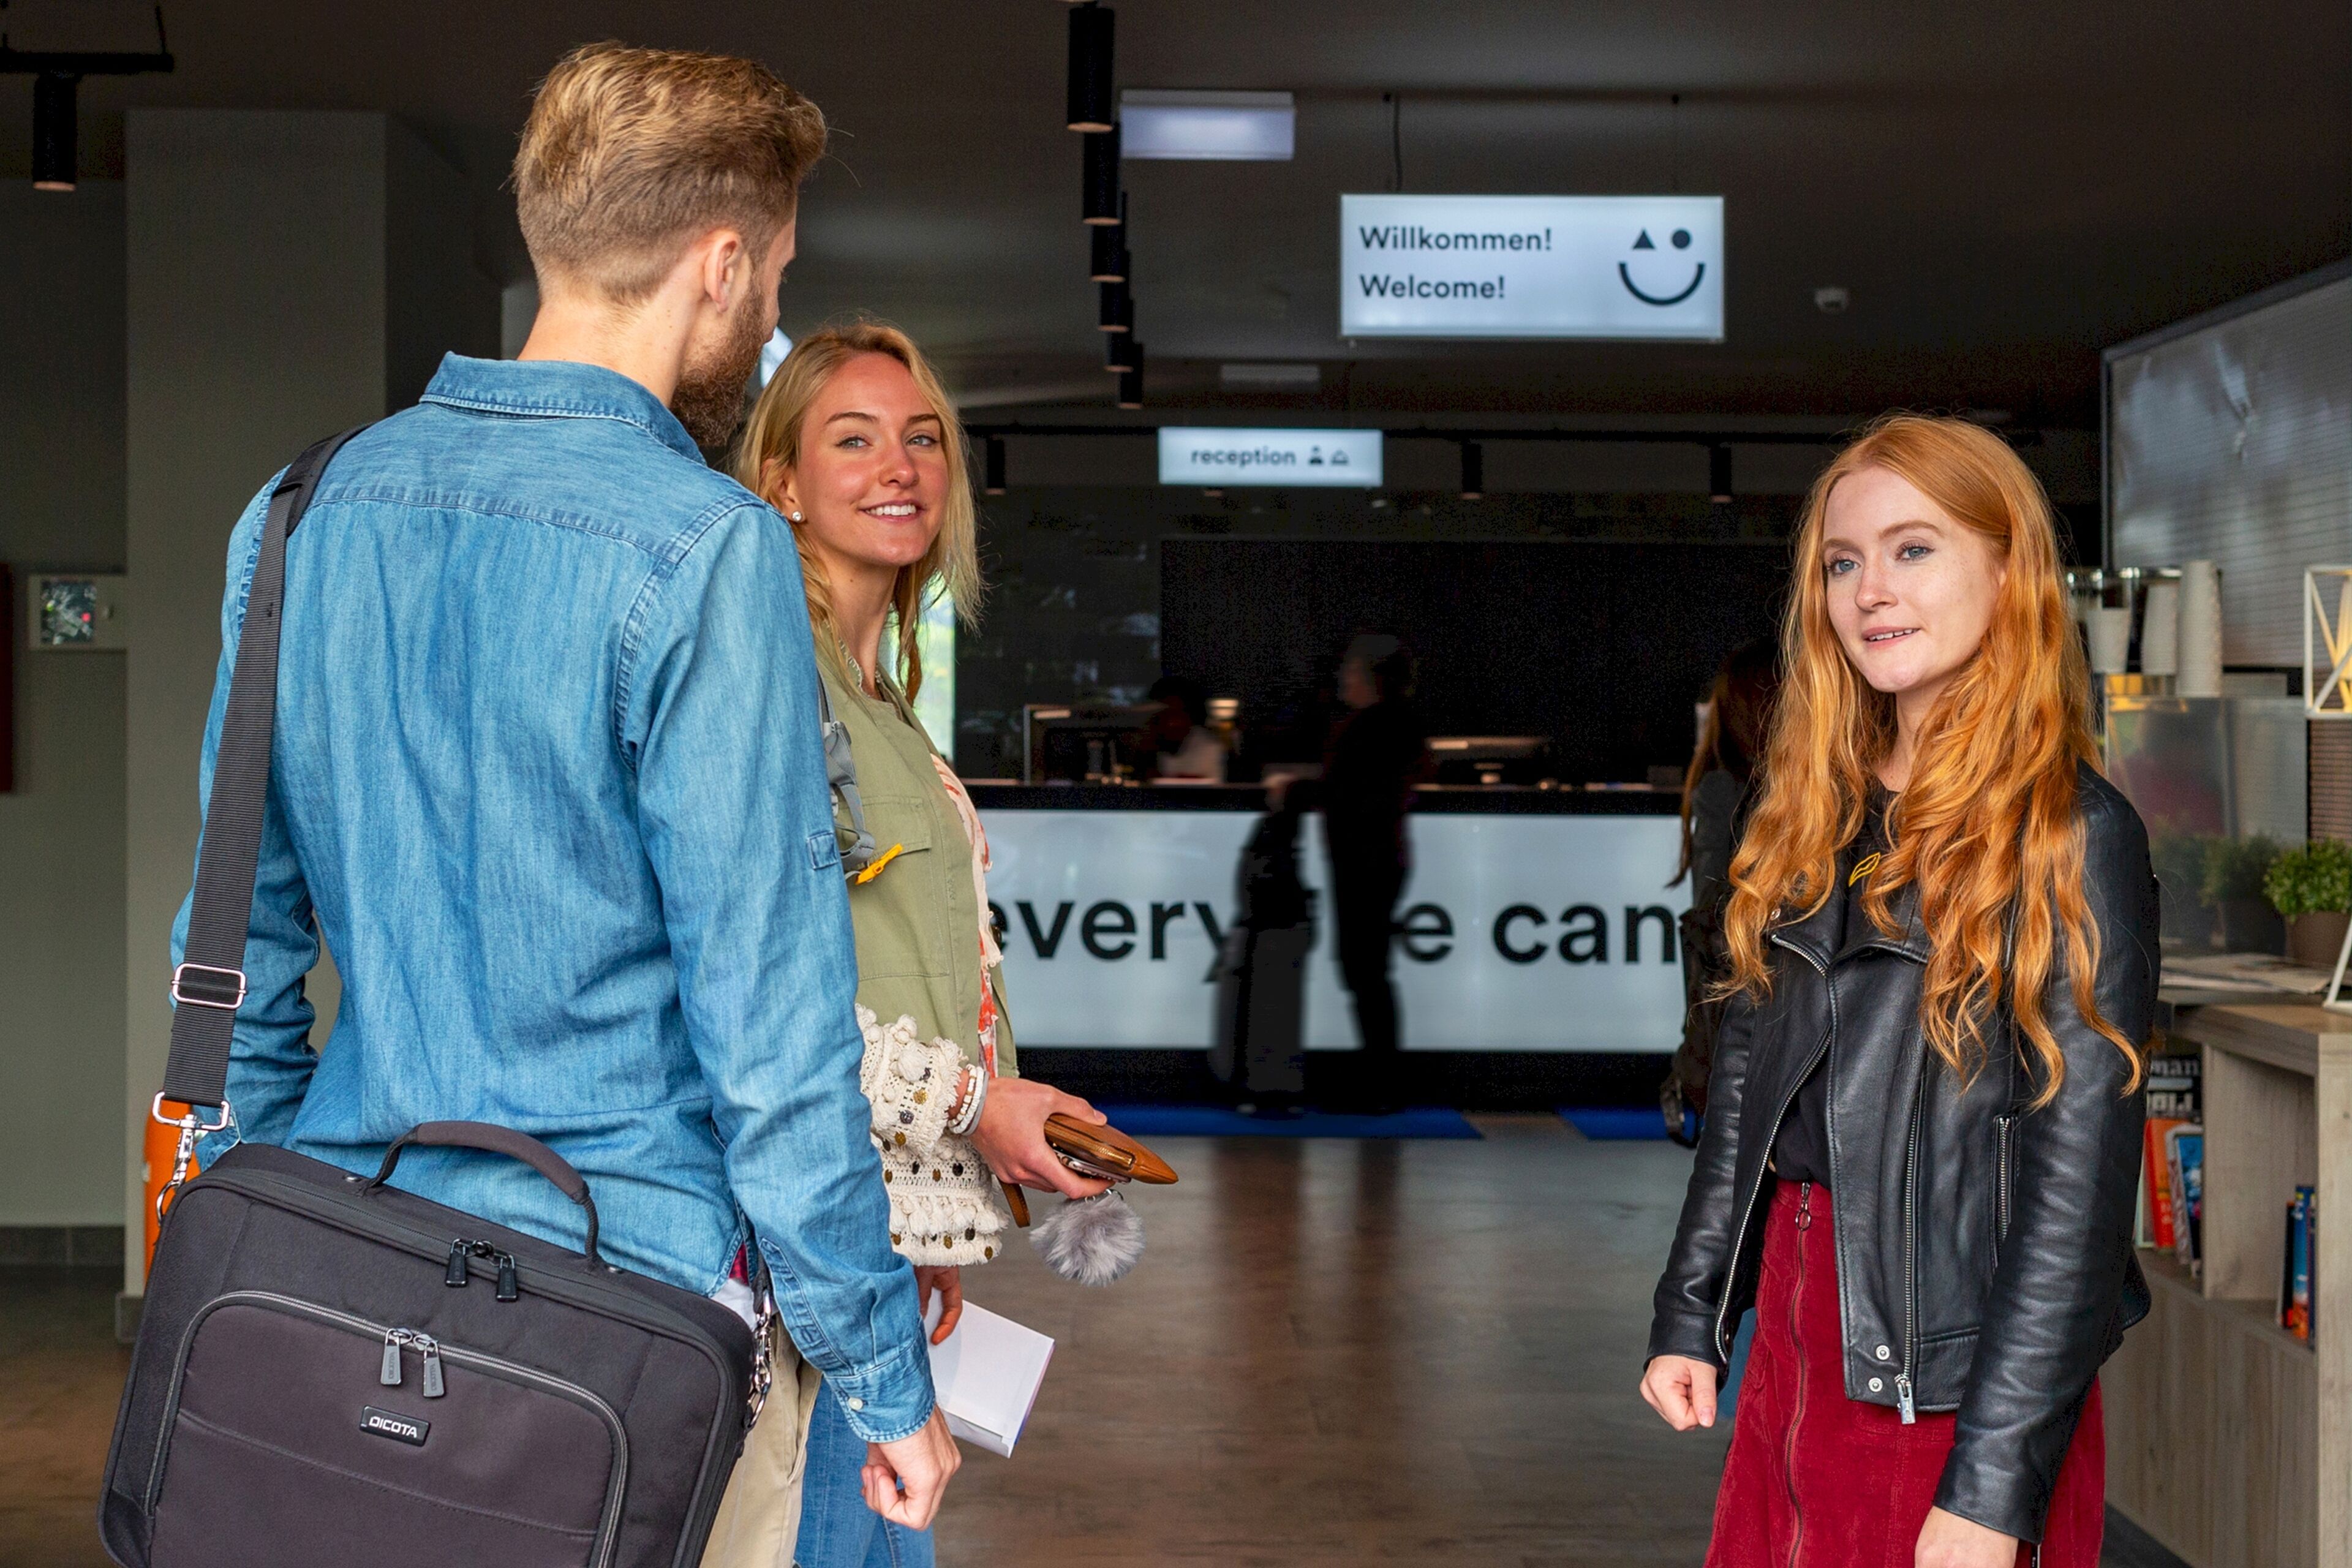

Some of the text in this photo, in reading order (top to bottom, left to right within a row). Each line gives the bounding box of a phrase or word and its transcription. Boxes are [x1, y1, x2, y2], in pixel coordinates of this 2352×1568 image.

[1359, 225, 1552, 252] Willkommen!
[1359, 274, 1505, 300] Welcome!
[1191, 445, 1297, 467] reception
[1492, 902, 1677, 965] can
[368, 1415, 418, 1439] DICOTA
